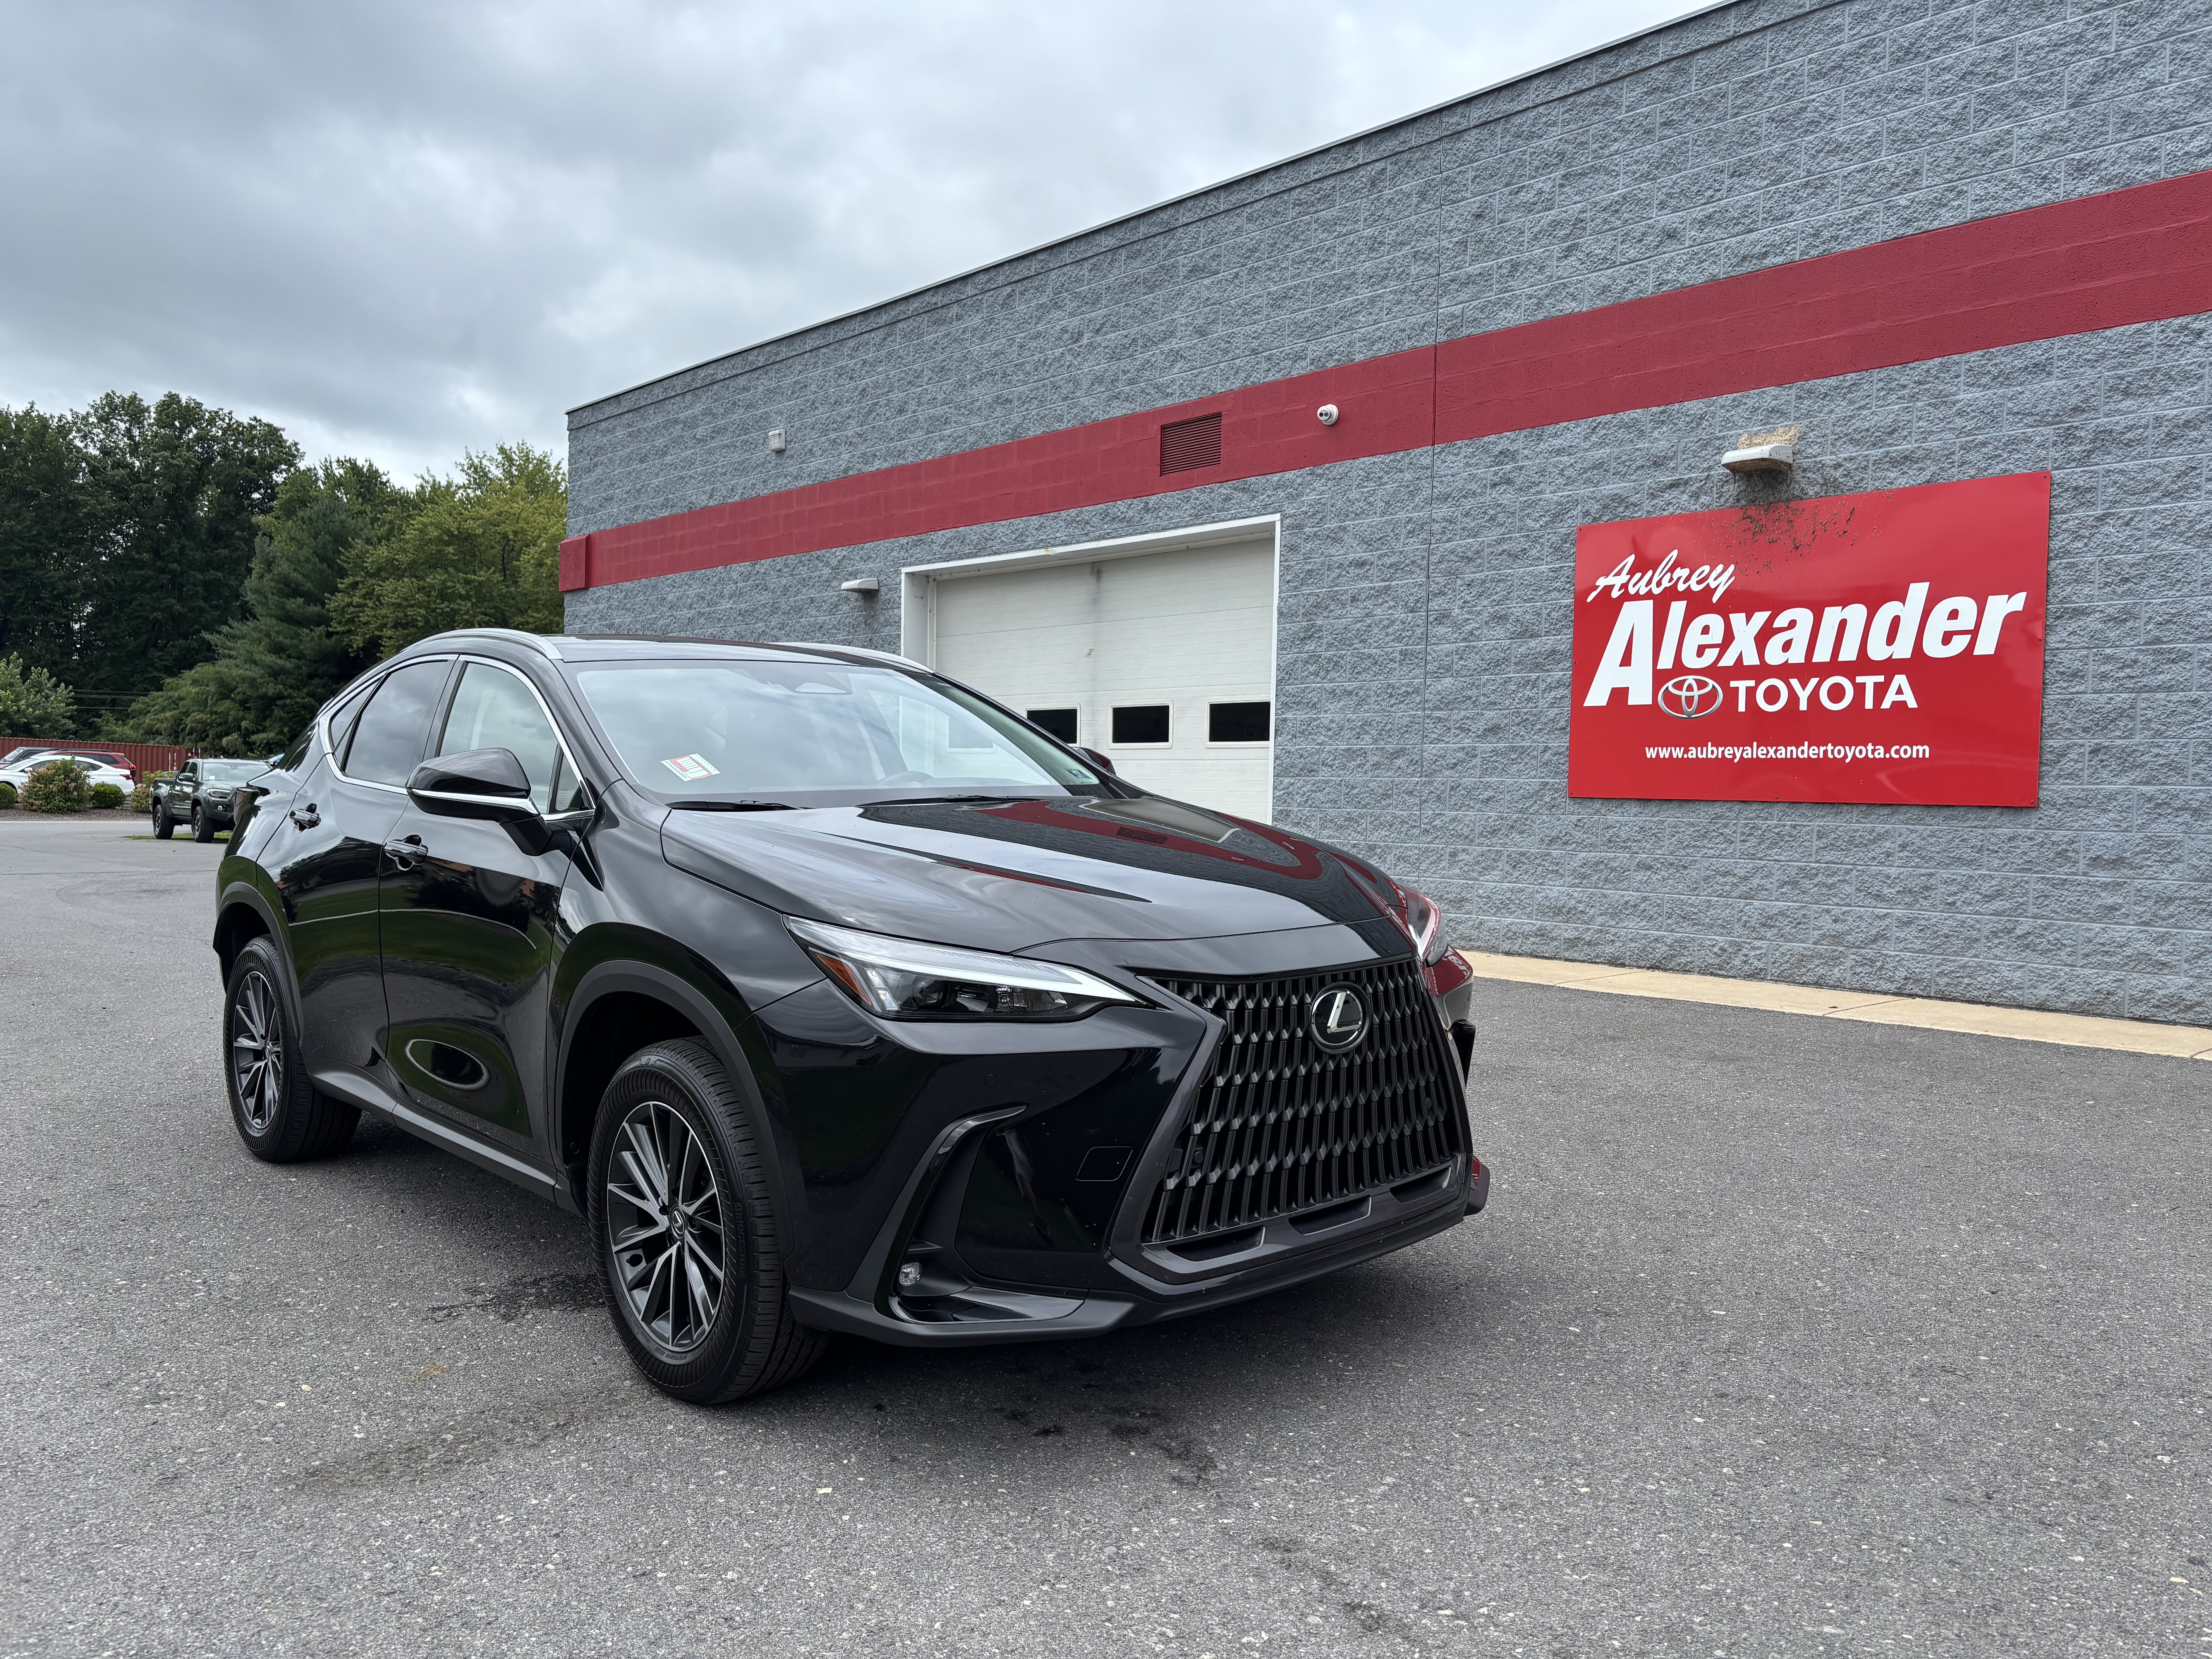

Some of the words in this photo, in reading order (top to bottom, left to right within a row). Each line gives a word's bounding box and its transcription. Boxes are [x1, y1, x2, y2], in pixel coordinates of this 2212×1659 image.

[1586, 549, 1735, 604] Aubrey
[1583, 582, 2027, 707] Alexander
[1729, 674, 1918, 712] TOYOTA
[1645, 741, 1929, 763] www.aubreyalexandertoyota.com
